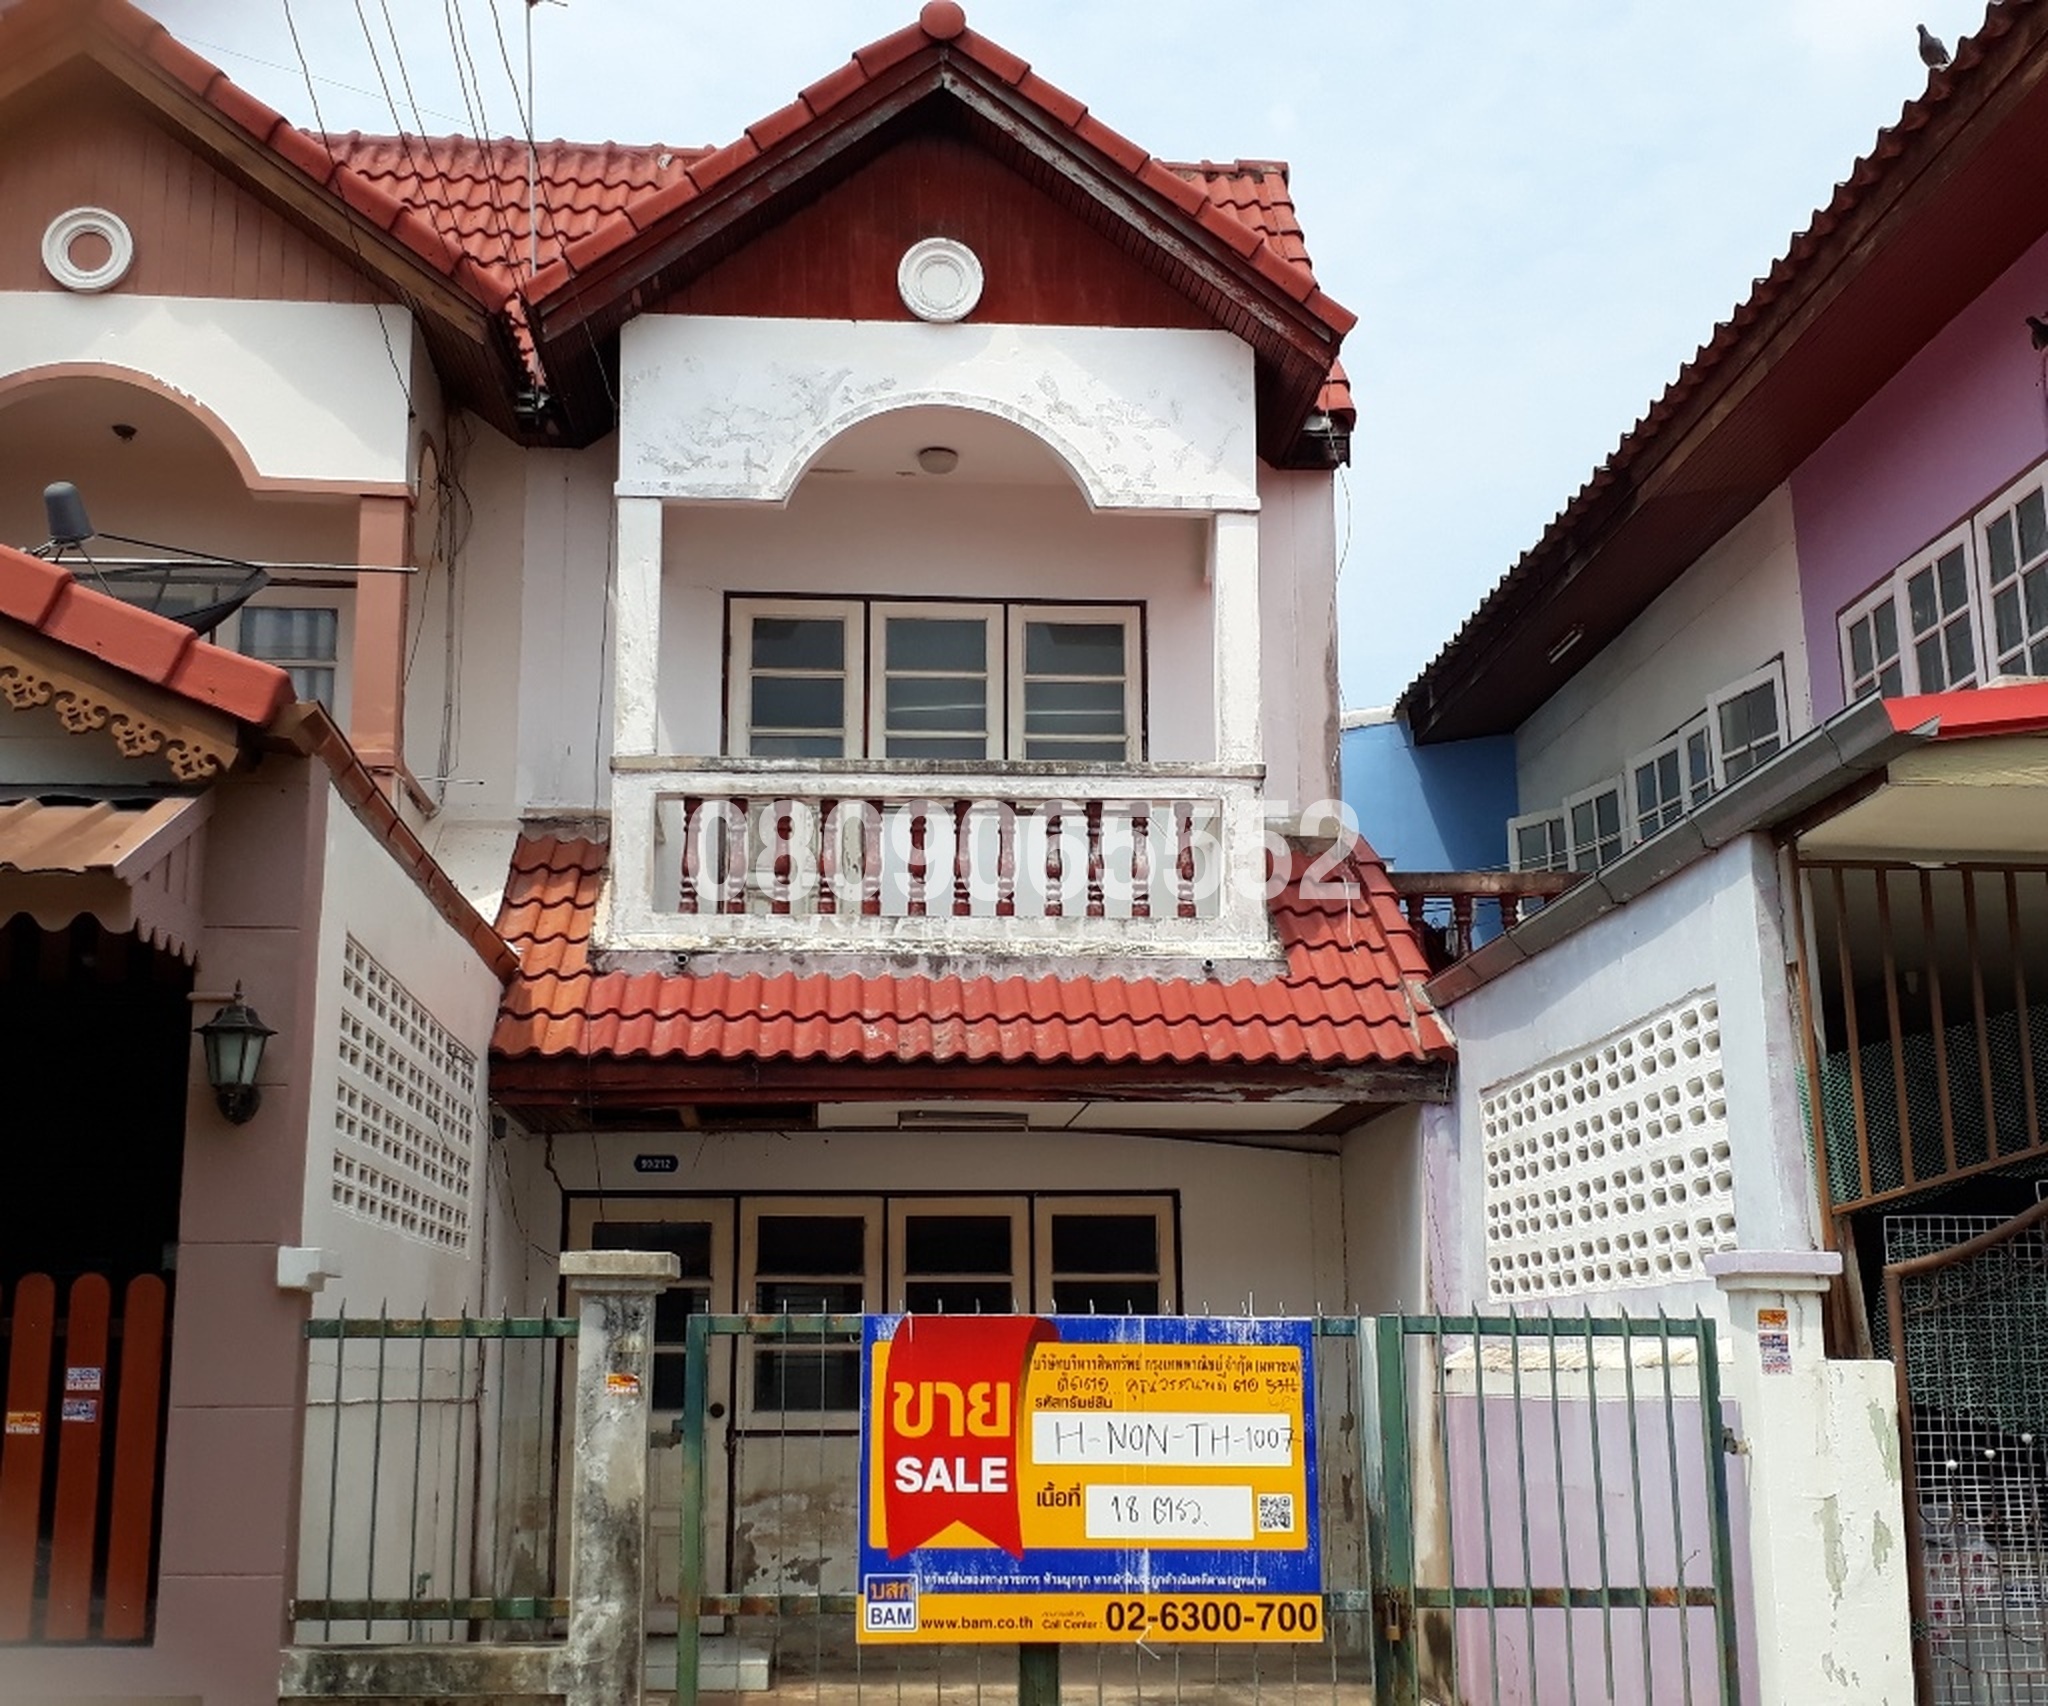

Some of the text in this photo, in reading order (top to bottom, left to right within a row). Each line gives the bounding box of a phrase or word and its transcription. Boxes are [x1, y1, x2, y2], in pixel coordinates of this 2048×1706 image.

[893, 1381, 1011, 1438] ขาย
[895, 1456, 1009, 1493] SALE
[1036, 1482, 1081, 1508] เนื้อที่
[871, 1607, 912, 1625] BAM
[921, 1616, 1033, 1630] www.bam.co.th
[1106, 1602, 1317, 1632] 02-6300-700
